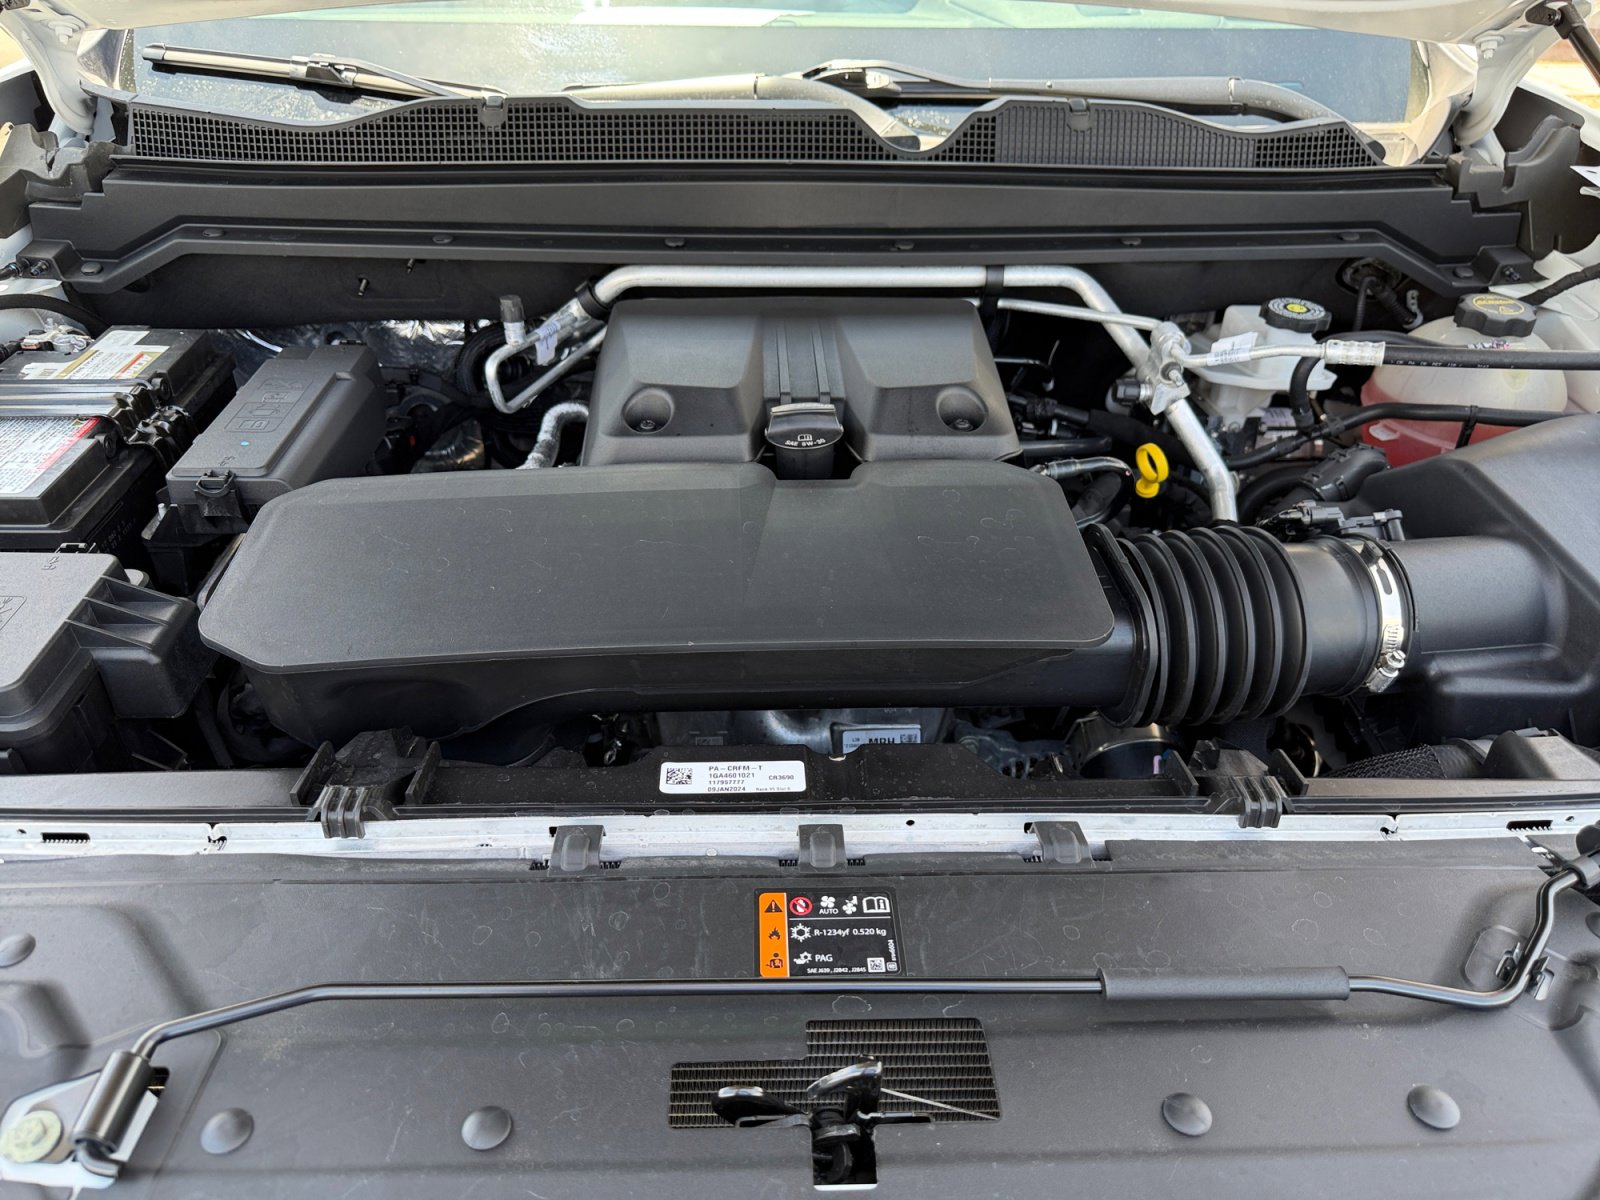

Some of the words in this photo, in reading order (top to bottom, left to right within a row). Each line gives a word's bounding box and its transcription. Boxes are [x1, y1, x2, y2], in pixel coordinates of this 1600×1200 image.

[813, 928, 850, 937] R-1234yf
[852, 928, 875, 936] 0.520
[876, 927, 887, 936] kg
[815, 954, 833, 962] PAG
